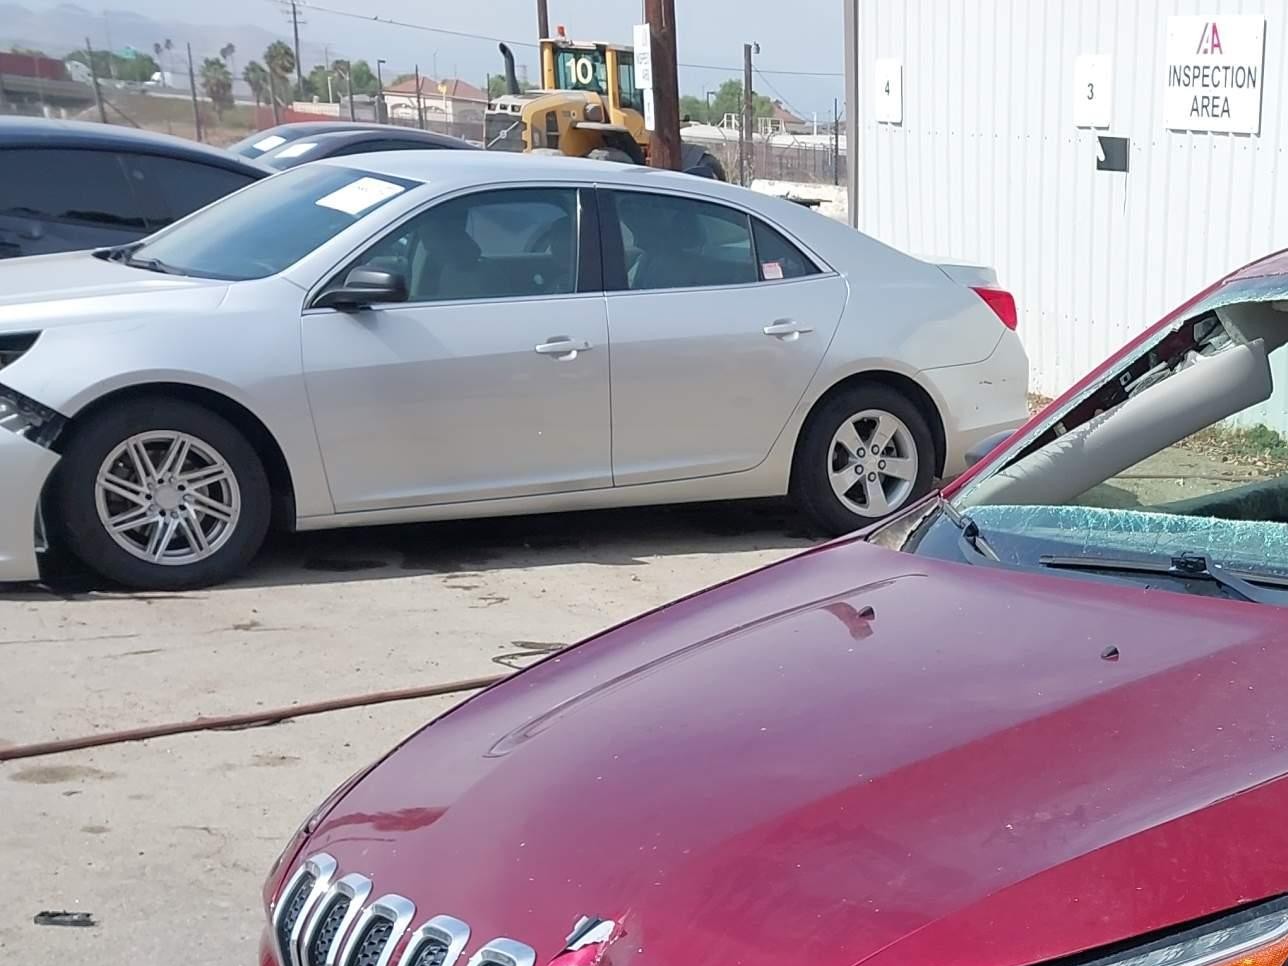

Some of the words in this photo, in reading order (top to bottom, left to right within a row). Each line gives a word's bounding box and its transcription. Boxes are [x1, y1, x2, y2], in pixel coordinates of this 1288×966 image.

[566, 57, 593, 84] 10
[1168, 64, 1257, 89] INSPECTION
[884, 80, 890, 96] 4
[1087, 83, 1094, 100] 3
[1190, 95, 1231, 118] AREA
